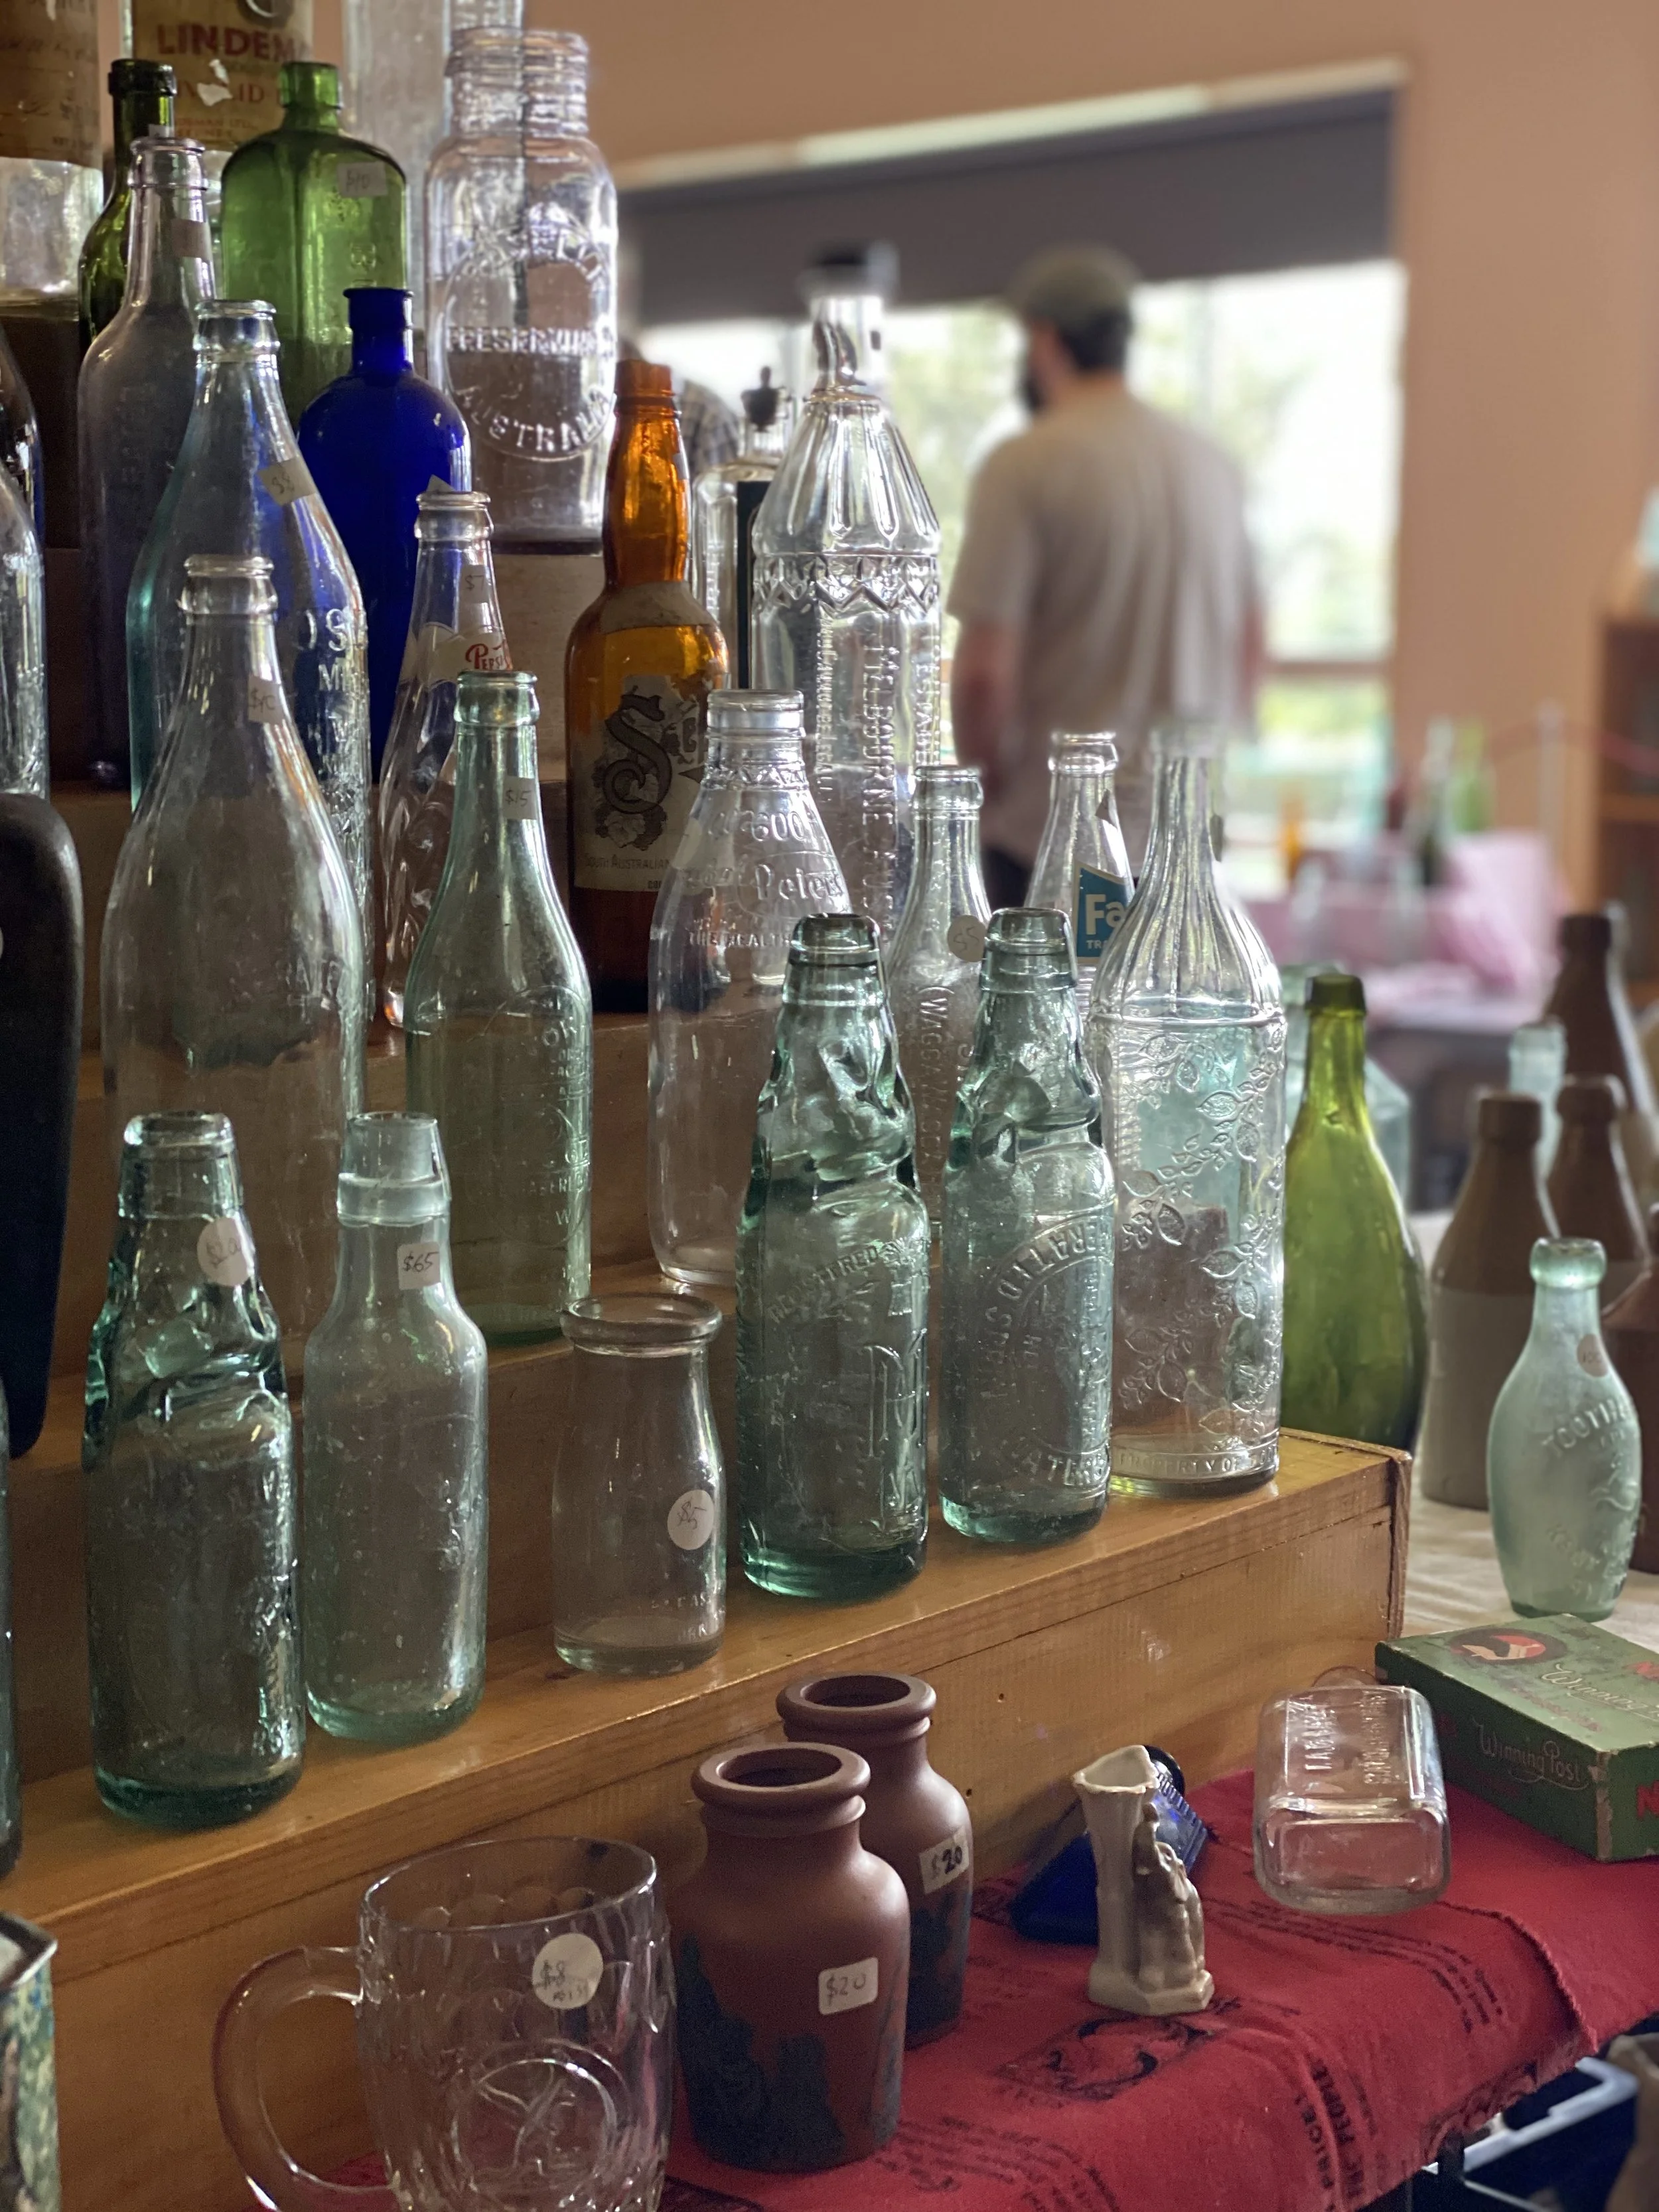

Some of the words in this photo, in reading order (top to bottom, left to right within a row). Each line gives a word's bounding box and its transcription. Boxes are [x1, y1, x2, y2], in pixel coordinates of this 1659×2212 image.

[465, 573, 485, 592] $7
[402, 1250, 439, 1272] $65
[1471, 1714, 1546, 1775] Winning
[1542, 1740, 1581, 1784] Post
[826, 1972, 867, 2007] $20
